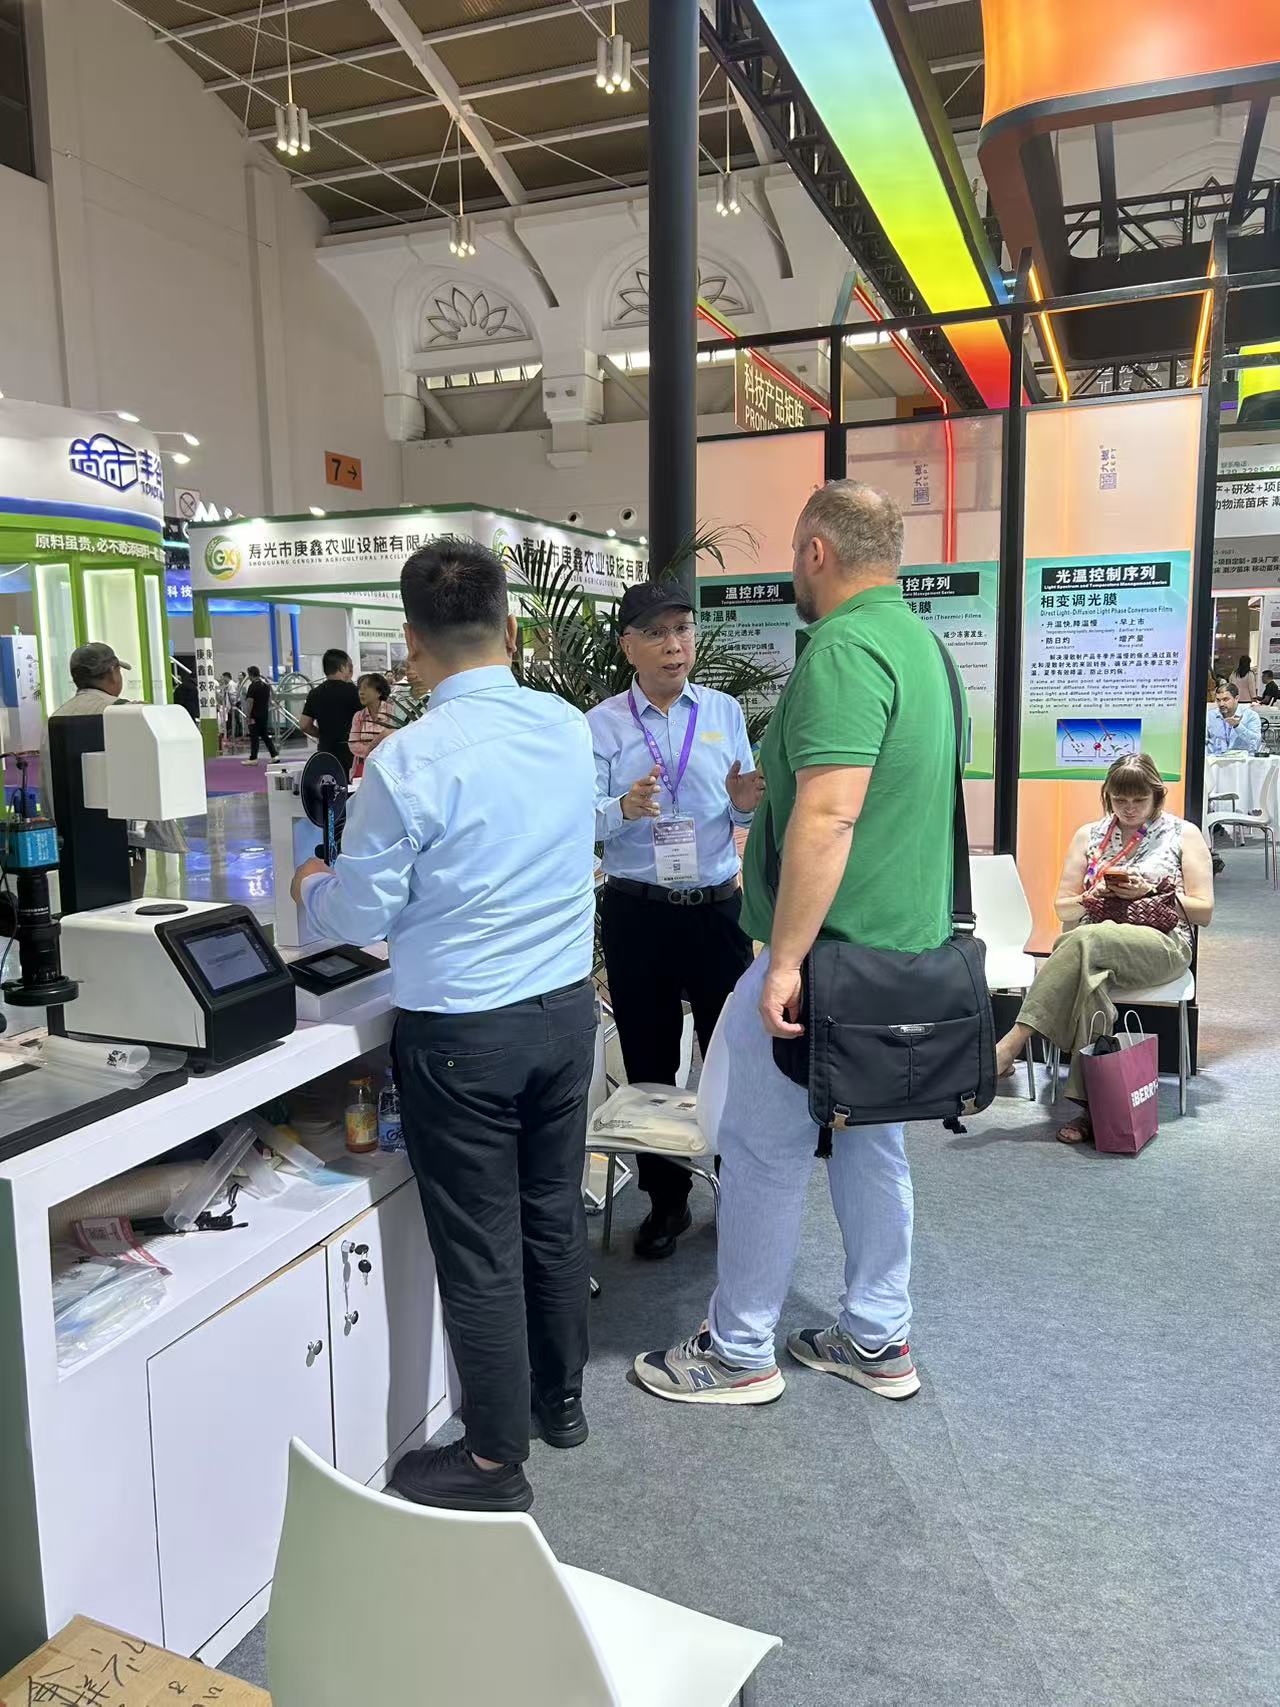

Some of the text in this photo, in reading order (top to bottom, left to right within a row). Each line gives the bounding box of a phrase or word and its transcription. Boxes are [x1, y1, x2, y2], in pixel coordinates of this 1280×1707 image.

[332, 458, 341, 481] 7
[249, 559, 289, 567] SHOUGUANG
[292, 557, 322, 565] GENGXIN
[325, 555, 378, 563] AGRICULTURAL
[1056, 565, 1156, 584] 光温控制序列
[725, 584, 780, 600] 温控序列
[1041, 592, 1117, 608] 相变调光膜
[700, 609, 737, 622] 降温膜
[688, 1366, 717, 1392] N
